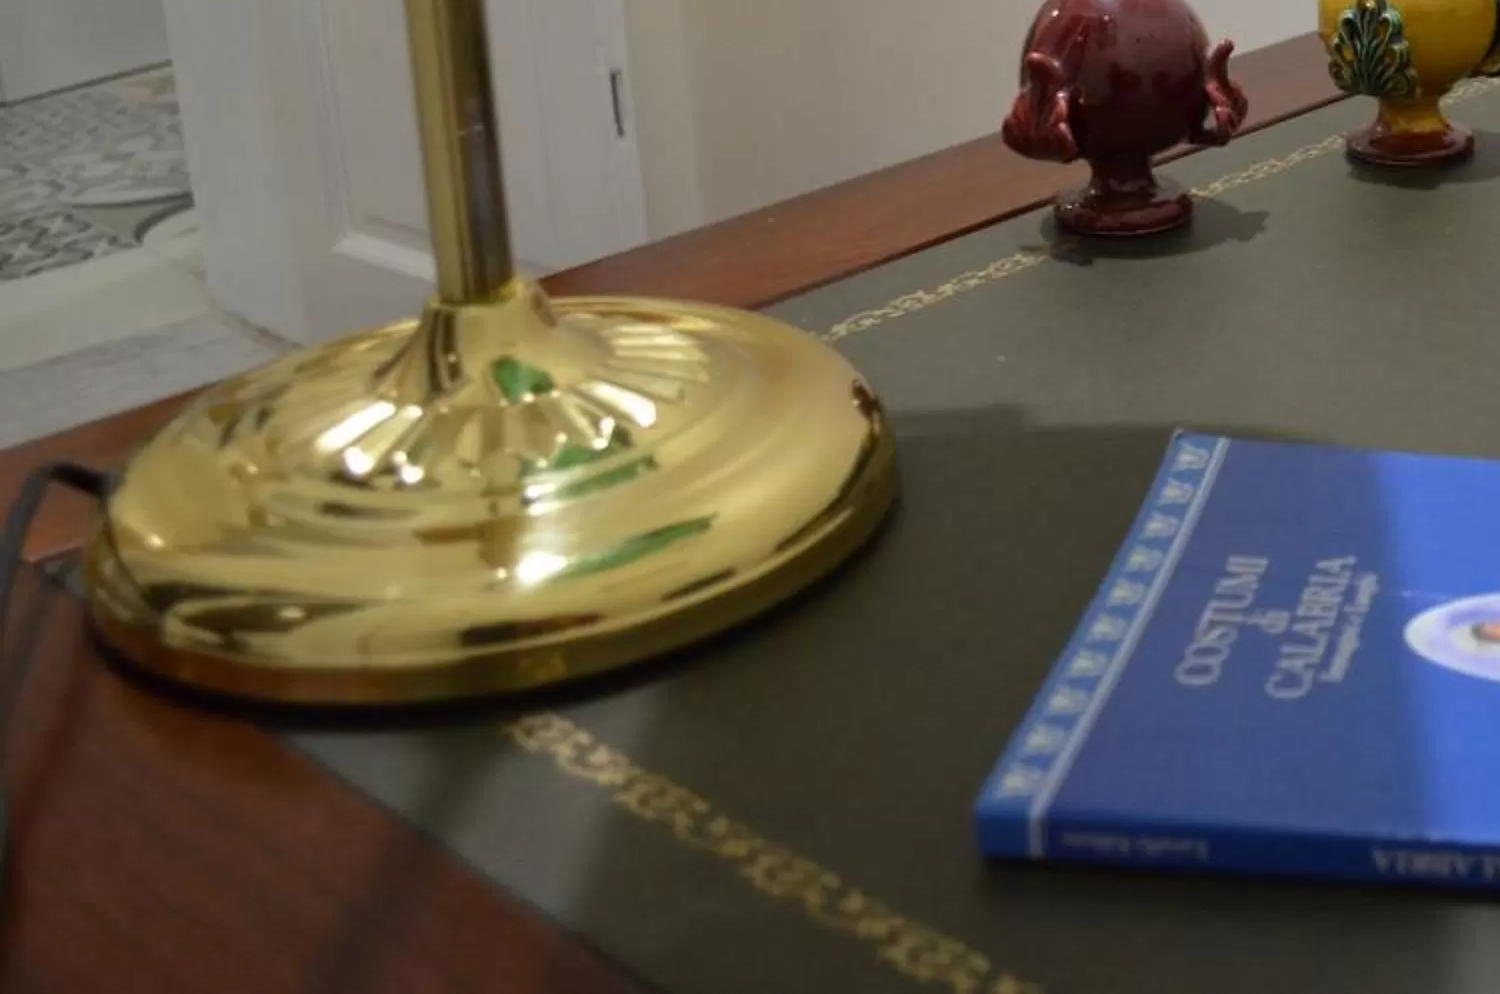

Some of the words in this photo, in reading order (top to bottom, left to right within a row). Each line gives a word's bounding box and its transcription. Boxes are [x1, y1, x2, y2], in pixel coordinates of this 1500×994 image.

[1174, 554, 1269, 685] COSTUMI
[1245, 608, 1291, 634] di
[1264, 555, 1358, 699] CALABRIA
